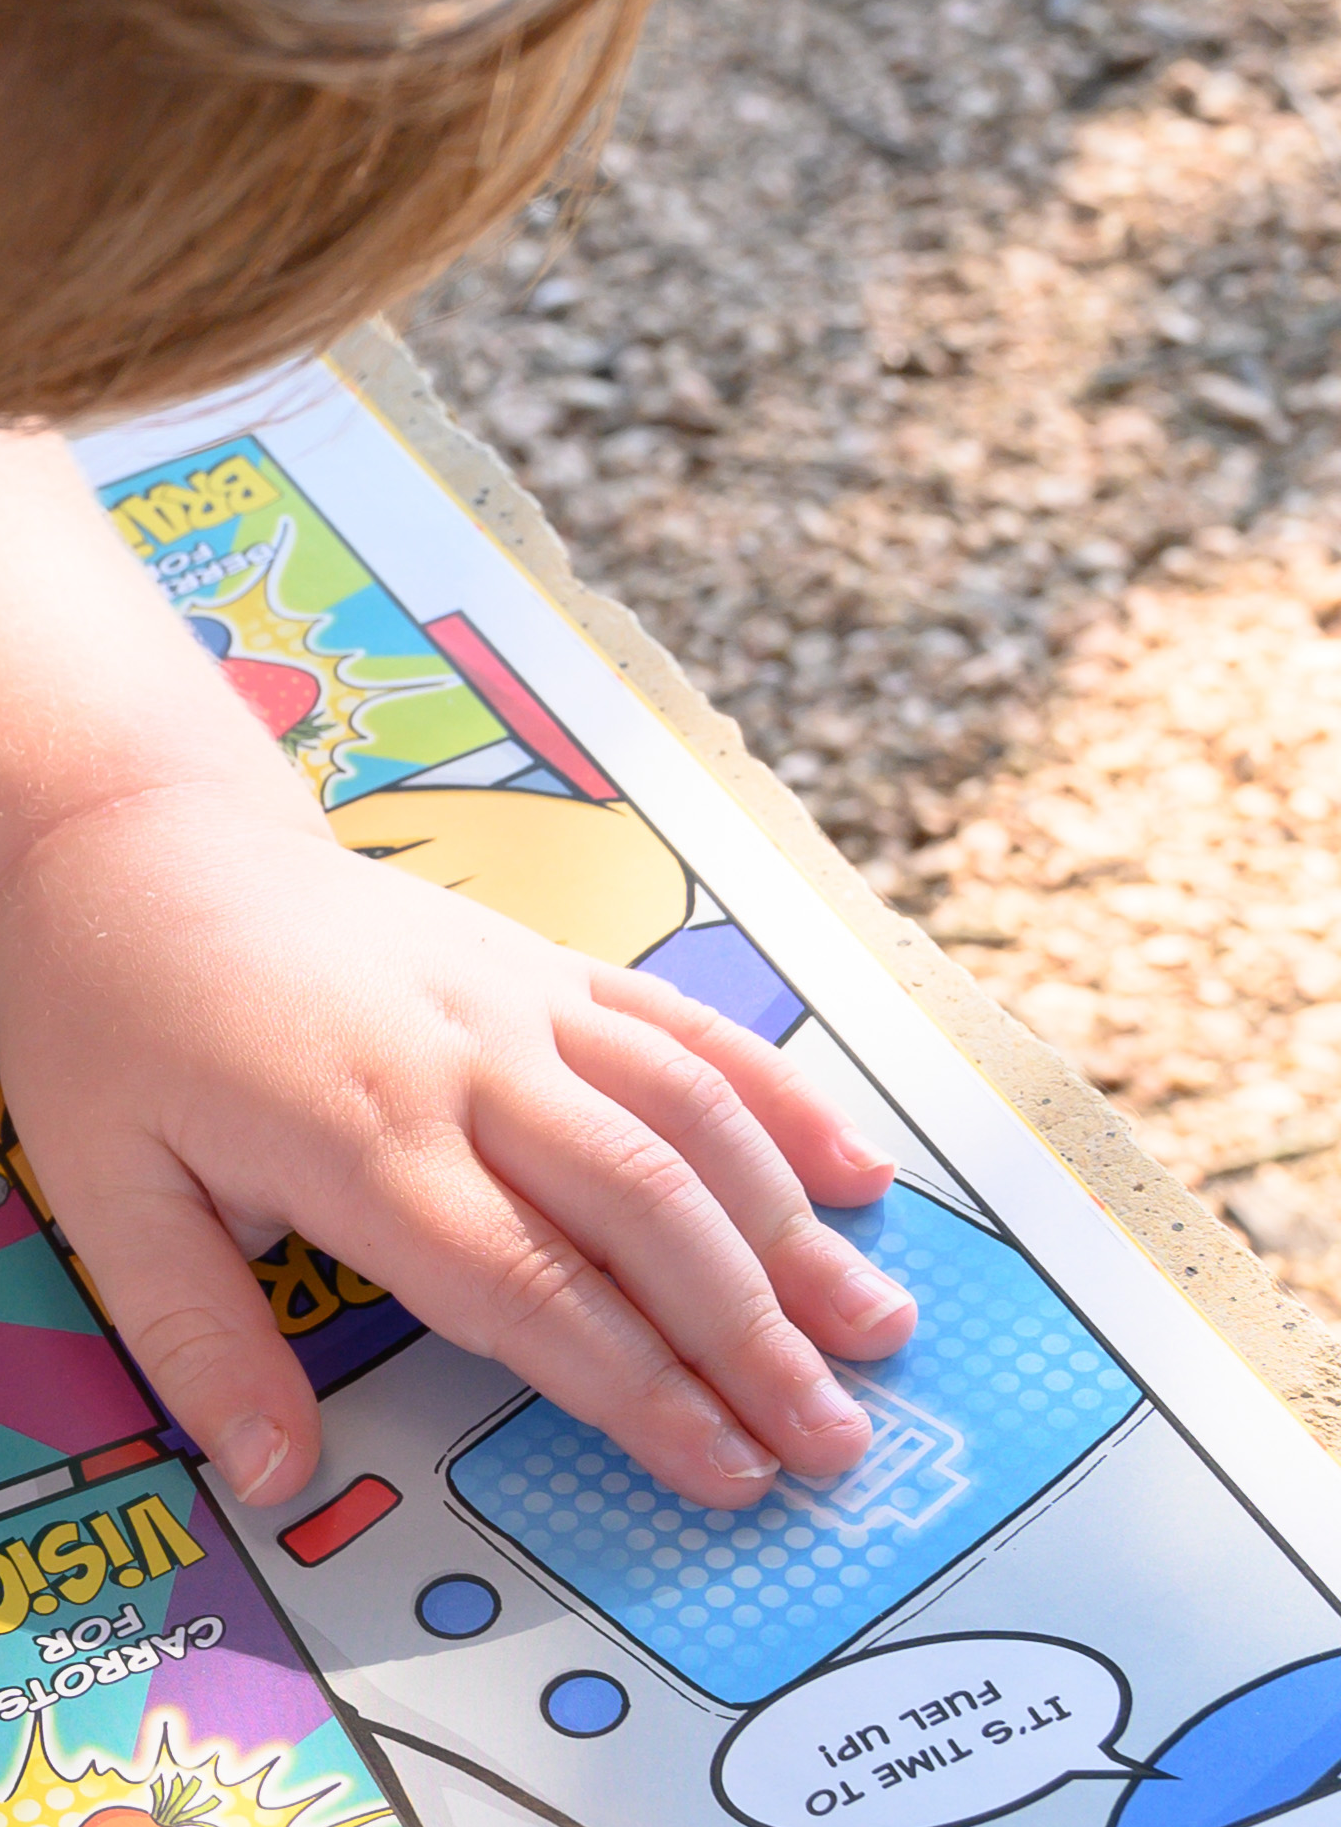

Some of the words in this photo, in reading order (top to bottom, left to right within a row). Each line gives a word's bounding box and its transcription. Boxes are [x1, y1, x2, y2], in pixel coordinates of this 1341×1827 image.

[158, 542, 274, 599] BERR
[33, 1602, 144, 1663] FOR
[899, 1679, 1002, 1729] FUEL
[980, 1695, 1072, 1747] IT'S
[817, 1723, 891, 1768] UP!
[870, 1737, 972, 1791] TIME
[804, 1780, 865, 1818] TO
